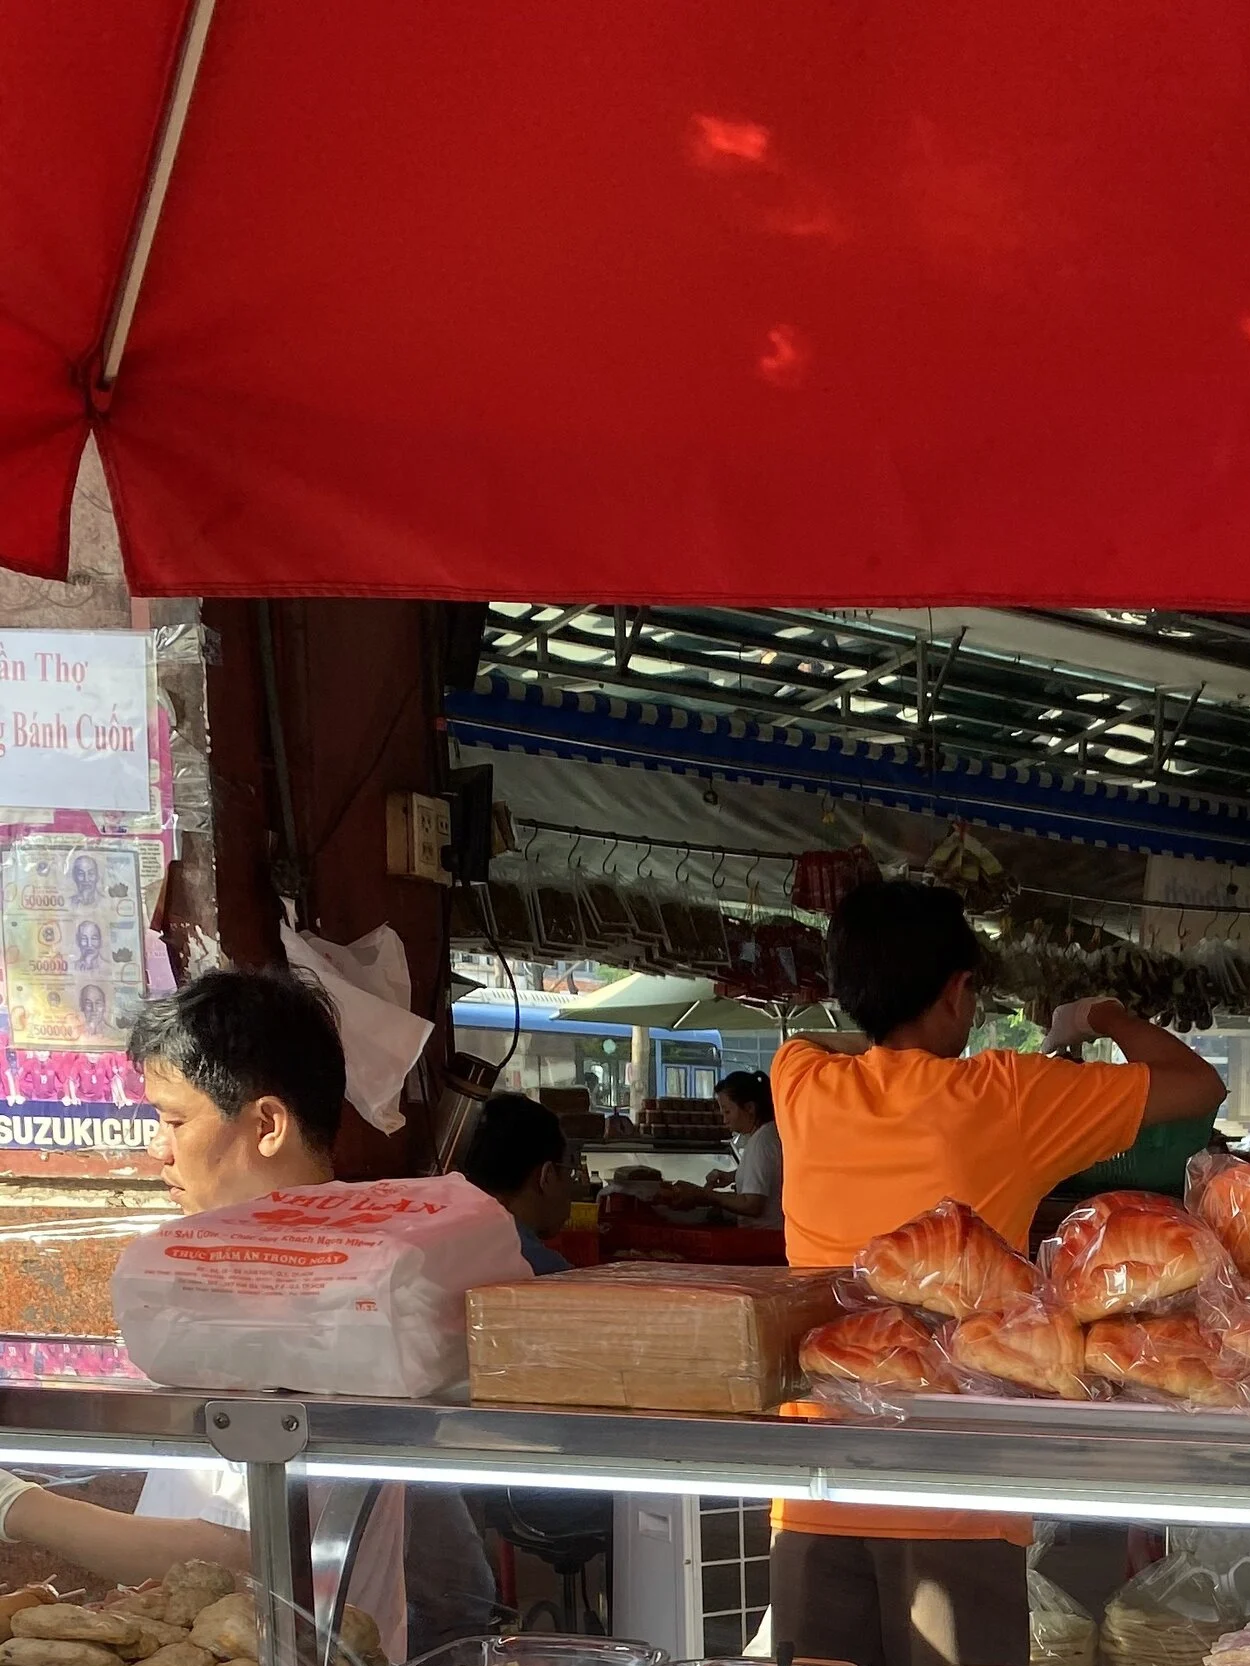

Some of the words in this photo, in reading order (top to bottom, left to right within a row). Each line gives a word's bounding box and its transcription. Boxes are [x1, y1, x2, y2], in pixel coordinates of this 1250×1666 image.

[34, 652, 88, 691] Thợ
[12, 711, 68, 749] Bánh
[76, 703, 135, 751] Cuốn
[263, 1253, 306, 1265] TRONG
